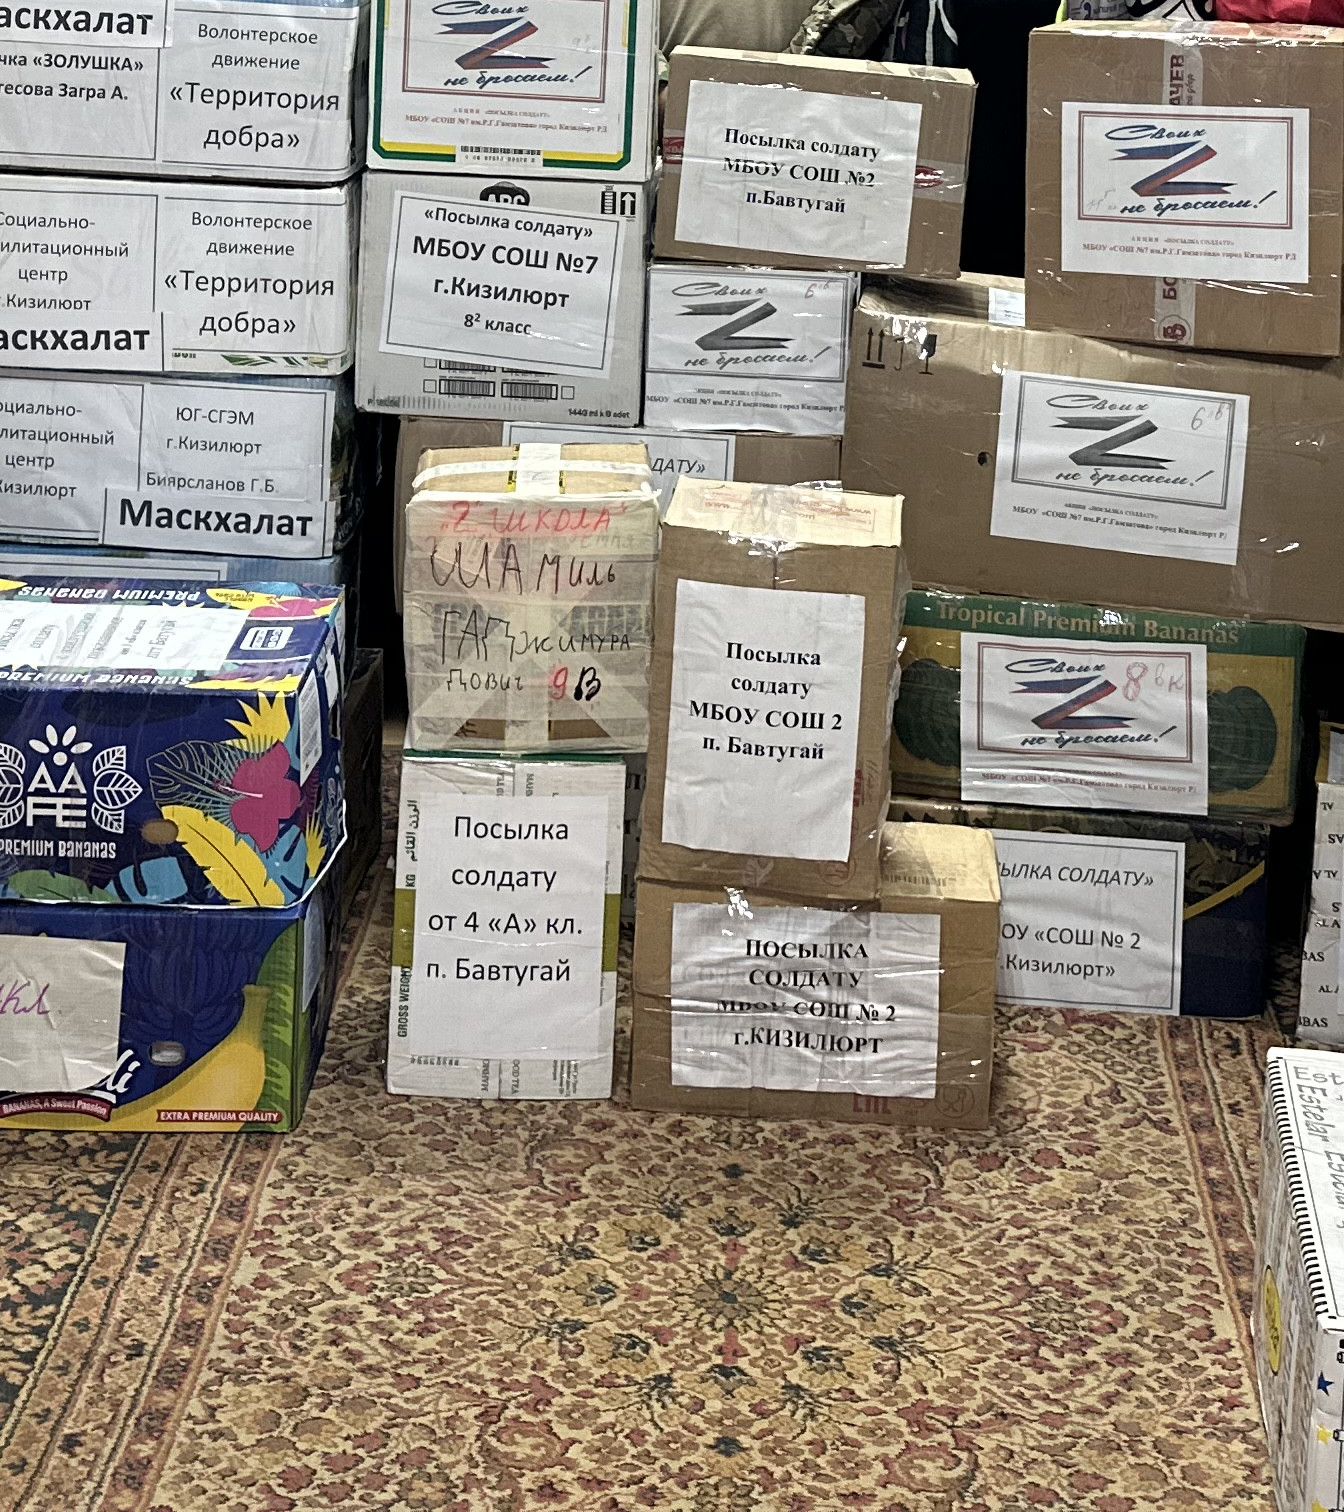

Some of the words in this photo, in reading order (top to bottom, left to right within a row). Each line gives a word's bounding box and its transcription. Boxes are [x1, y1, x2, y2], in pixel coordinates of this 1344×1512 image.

[198, 23, 318, 45] Волонтерское
[33, 53, 145, 73] «ЗОЛУШКА»
[212, 54, 300, 72] движение
[58, 83, 106, 102] Загра
[111, 86, 129, 101] А.
[169, 81, 340, 115] «Территория
[203, 125, 300, 154] добра»
[745, 190, 846, 214] п.Бавтугай
[412, 235, 487, 266] МБОУ
[491, 245, 549, 270] СОШ
[555, 250, 599, 276] №7
[433, 275, 570, 310] г.Кизилюрт
[485, 317, 532, 336] класс
[176, 406, 255, 426] ЮГ-СГЭМ
[166, 435, 262, 457] г.Кизилюрт
[146, 472, 246, 493] Биярсланов
[250, 478, 280, 493] Г.Б.
[119, 498, 313, 538] Маскхалат
[936, 602, 1025, 628] Tropical
[1033, 610, 1139, 638] Premium
[1143, 620, 1239, 645] Bananas
[454, 816, 569, 840] Посылка
[58, 841, 117, 860] BANANAS
[405, 874, 416, 888] KG
[451, 870, 557, 892] солдату
[428, 914, 458, 932] от
[464, 911, 480, 933] 4
[488, 913, 536, 934] «А»
[546, 917, 583, 935] кл.
[426, 963, 447, 979] п.
[456, 958, 570, 986] Бавтугай
[398, 1004, 409, 1038] GROSS
[159, 1110, 190, 1121] EXTRA
[191, 1111, 236, 1122] PREMIUM
[237, 1111, 279, 1123] QUALITY
